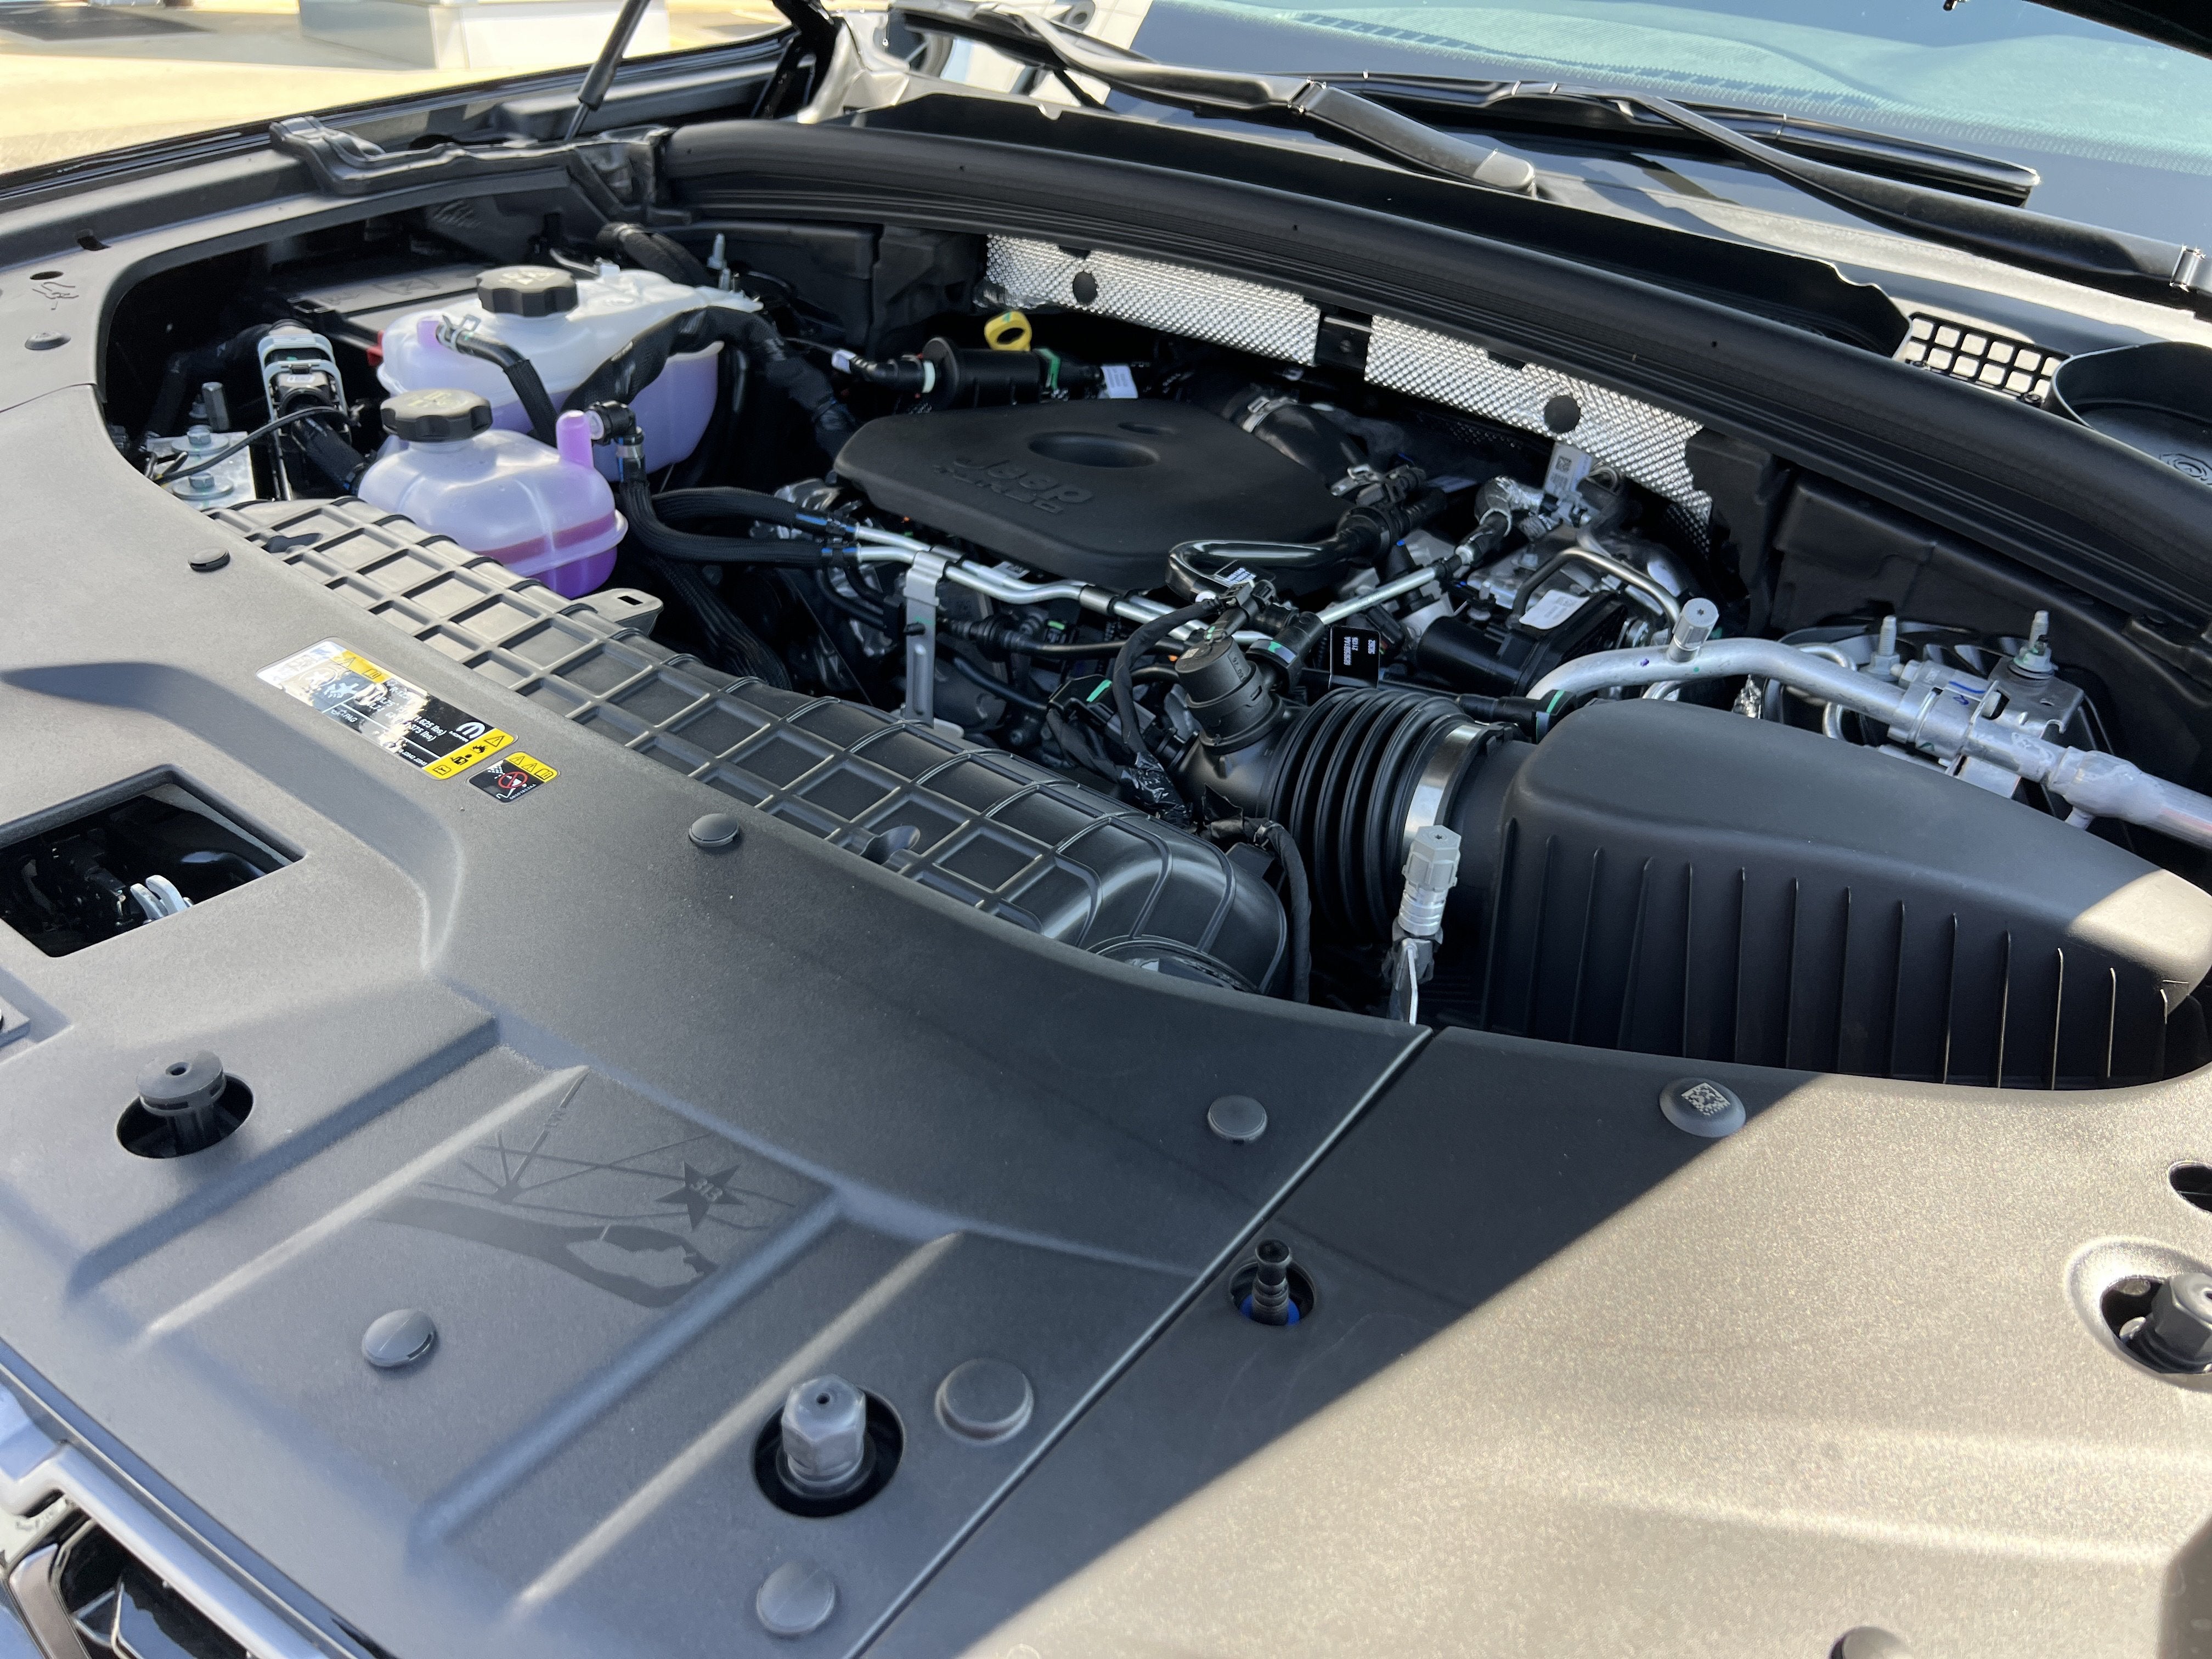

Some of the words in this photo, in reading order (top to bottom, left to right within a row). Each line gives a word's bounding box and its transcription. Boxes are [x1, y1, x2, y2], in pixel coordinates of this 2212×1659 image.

[953, 460, 1093, 504] Jeep
[420, 730, 437, 742] lbs)
[431, 724, 447, 736] lbs)
[689, 1178, 723, 1203] 313
